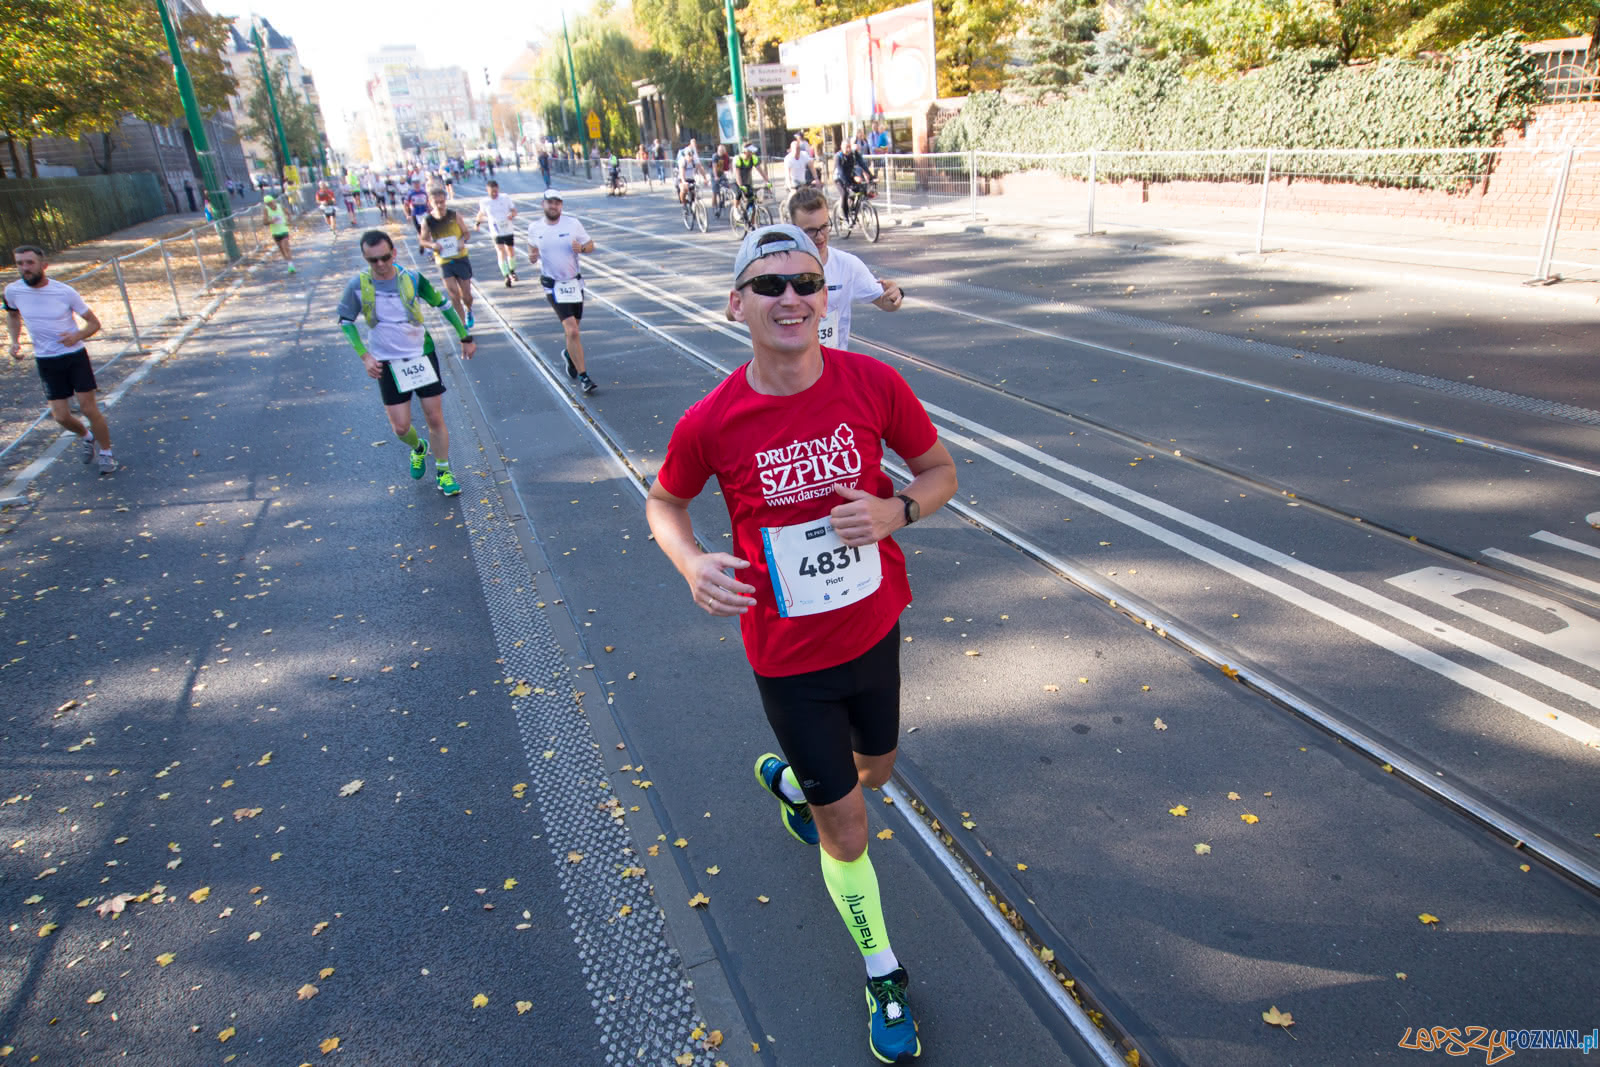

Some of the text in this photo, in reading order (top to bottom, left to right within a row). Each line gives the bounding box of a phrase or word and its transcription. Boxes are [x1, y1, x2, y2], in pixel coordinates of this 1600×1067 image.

[401, 364, 424, 377] 1436
[755, 435, 843, 468] DRUŻYNA
[760, 448, 862, 495] SZPIKU
[798, 546, 861, 578] 4831
[825, 576, 844, 587] Piotr
[840, 894, 877, 949] kalenji
